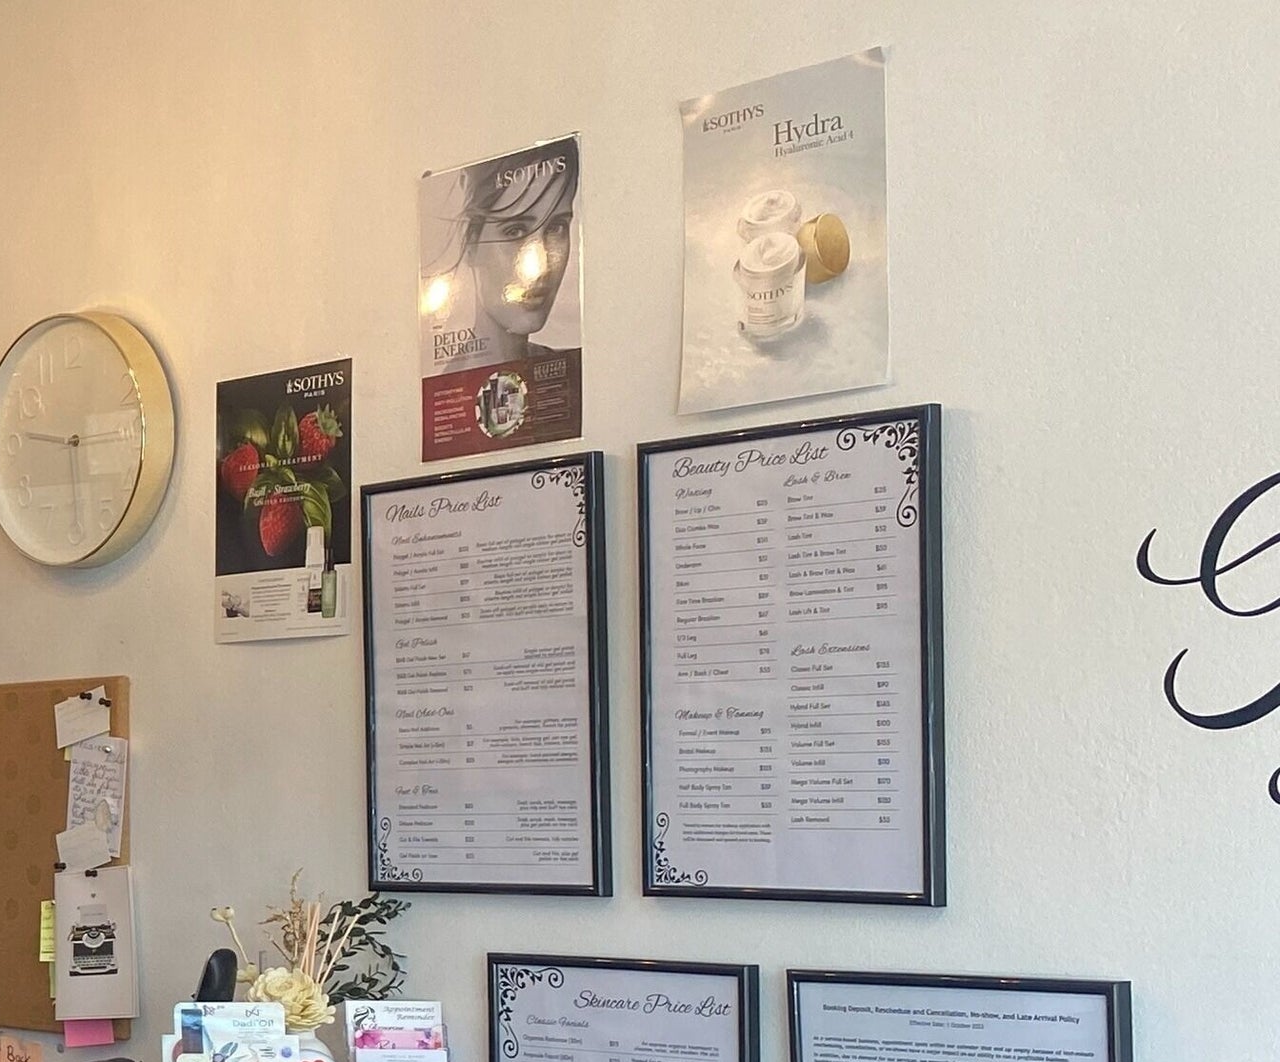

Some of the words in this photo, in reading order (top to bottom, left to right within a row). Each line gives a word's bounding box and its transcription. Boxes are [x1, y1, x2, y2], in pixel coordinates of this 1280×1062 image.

[709, 103, 765, 130] SOTHYS
[773, 113, 843, 146] Hydra
[774, 138, 823, 158] Hyaluronic
[826, 134, 846, 146] Acid
[503, 156, 566, 188] SOTHYS
[746, 282, 794, 301] SOTHYS
[434, 328, 477, 347] DETOX
[434, 339, 487, 361] ENERGIE
[294, 371, 344, 393] SOTHYS
[304, 390, 325, 398] PARIS
[277, 454, 323, 467] TREATMENT
[672, 457, 731, 478] Beauty
[735, 449, 786, 473] Price
[789, 441, 829, 465] List
[248, 484, 267, 499] Basil
[274, 483, 311, 497] Strawberry
[783, 476, 808, 487] Lash
[675, 487, 712, 499] Waxing
[386, 504, 425, 523] Nails
[429, 497, 470, 518] Price
[471, 490, 503, 512] List
[791, 645, 815, 656] Lash
[818, 643, 870, 655] Extensions
[675, 709, 712, 720] Makeup
[726, 706, 764, 720] Tanning
[383, 1006, 435, 1015] Appointment
[573, 989, 640, 1011] Skincare
[643, 993, 693, 1016] Price
[694, 996, 731, 1018] List
[526, 1014, 557, 1026] Classic
[823, 1003, 847, 1013] Booking
[912, 1008, 925, 1016] and
[1002, 1012, 1015, 1020] and
[1016, 1013, 1032, 1022] Late
[1033, 1013, 1057, 1023] Arrival
[1058, 1015, 1080, 1025] Policy
